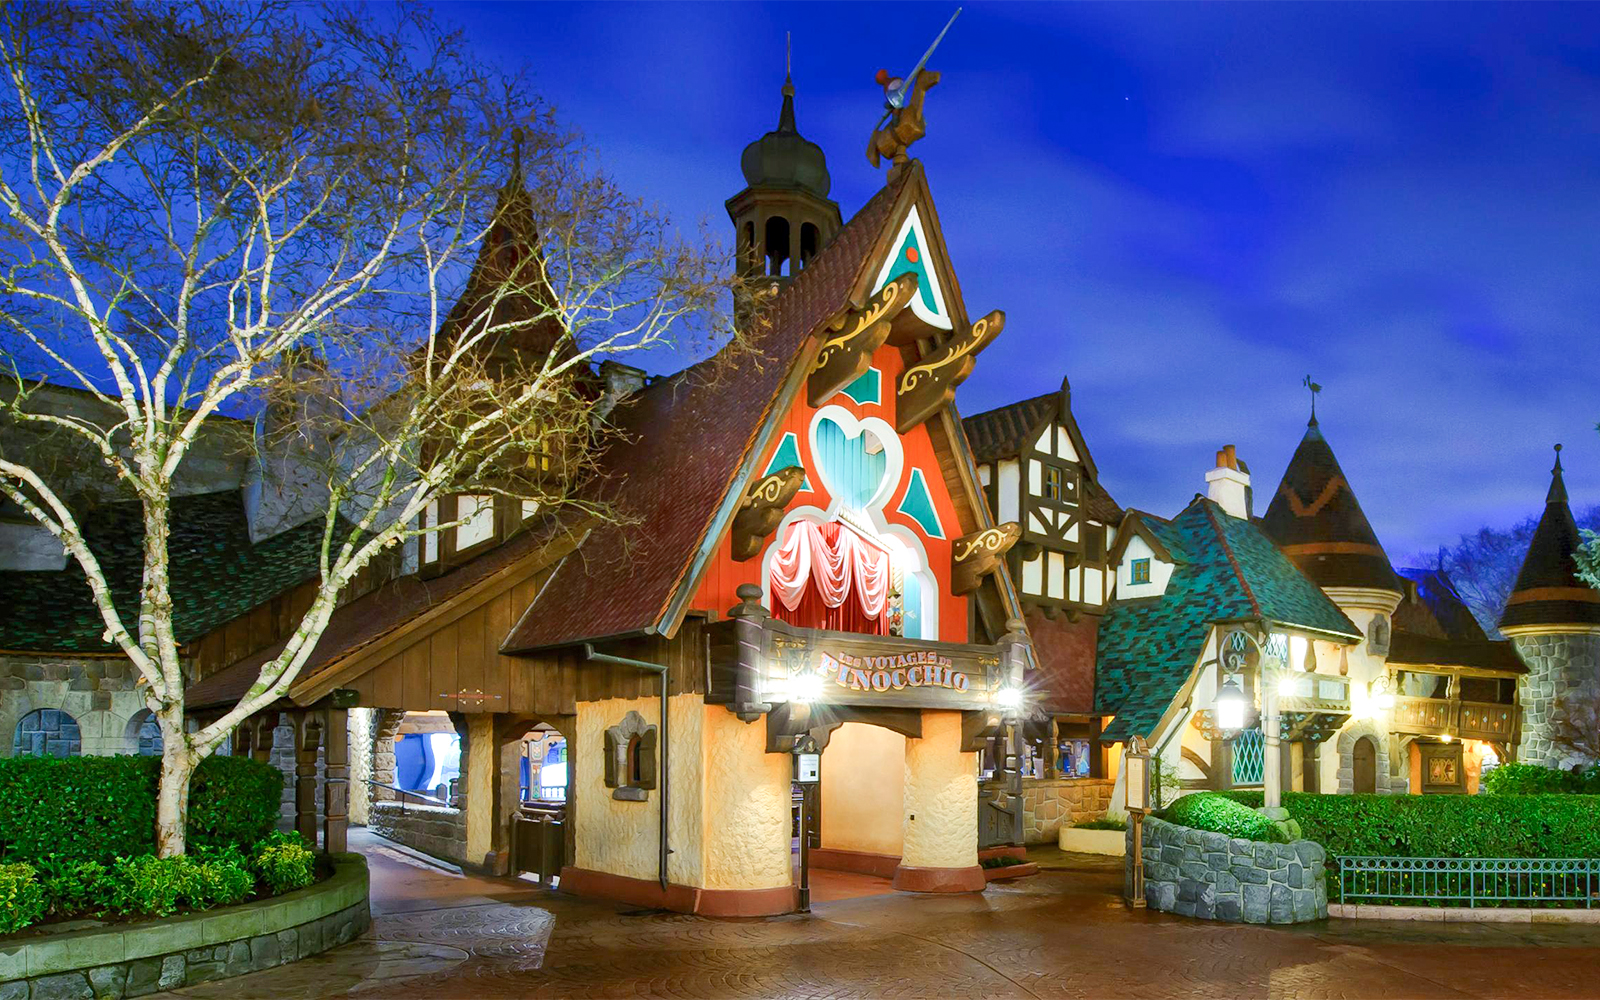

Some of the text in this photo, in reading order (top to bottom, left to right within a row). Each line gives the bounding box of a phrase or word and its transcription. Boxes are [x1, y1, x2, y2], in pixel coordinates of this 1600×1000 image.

[816, 651, 970, 694] PINOCCHIO
[863, 651, 937, 669] VOYAGES
[938, 657, 953, 667] DE
